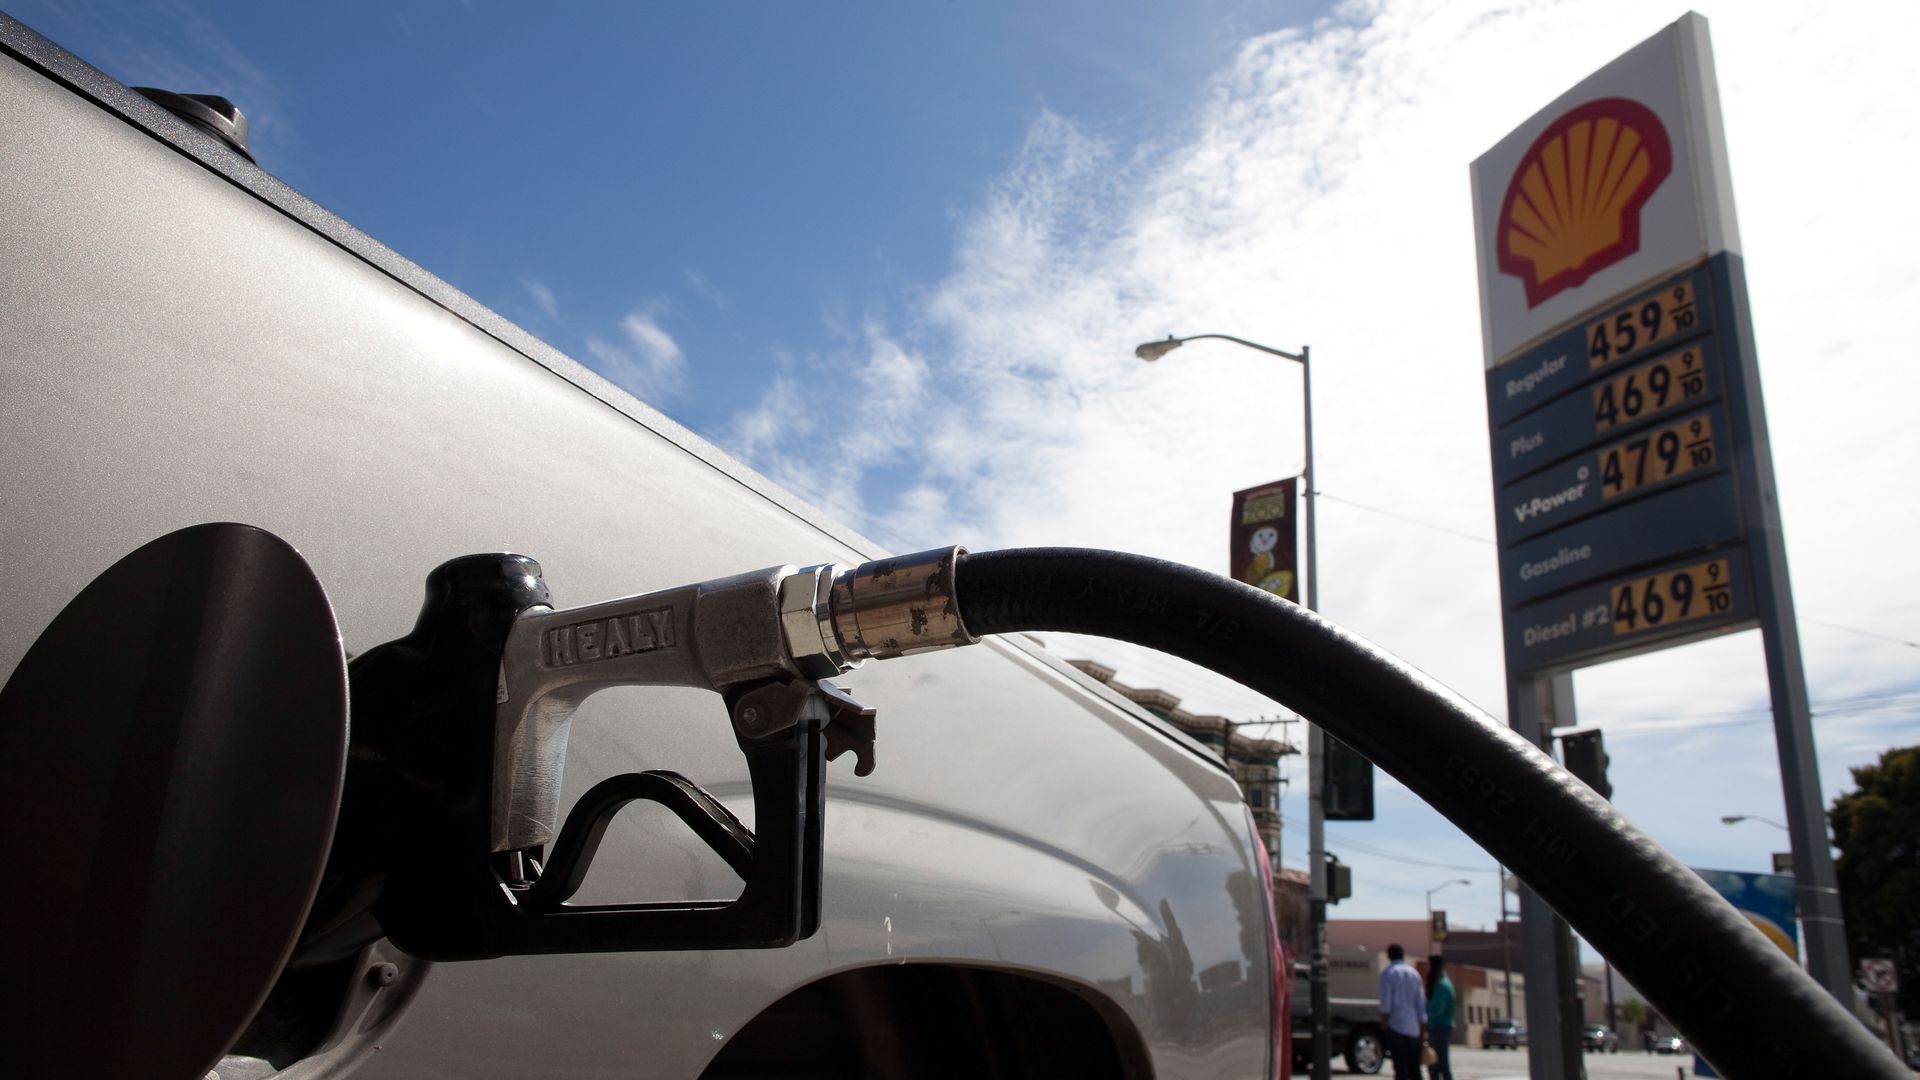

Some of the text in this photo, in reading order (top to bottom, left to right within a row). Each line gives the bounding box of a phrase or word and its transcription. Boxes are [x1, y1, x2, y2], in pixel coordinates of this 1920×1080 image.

[1505, 301, 1662, 398] Regular 459
[1510, 363, 1671, 458] Plus 469
[1514, 430, 1680, 523] V-Power 479
[1519, 544, 1592, 581] Gasoline
[547, 607, 674, 667] HEALY
[1523, 572, 1695, 647] Diesel #2 469
